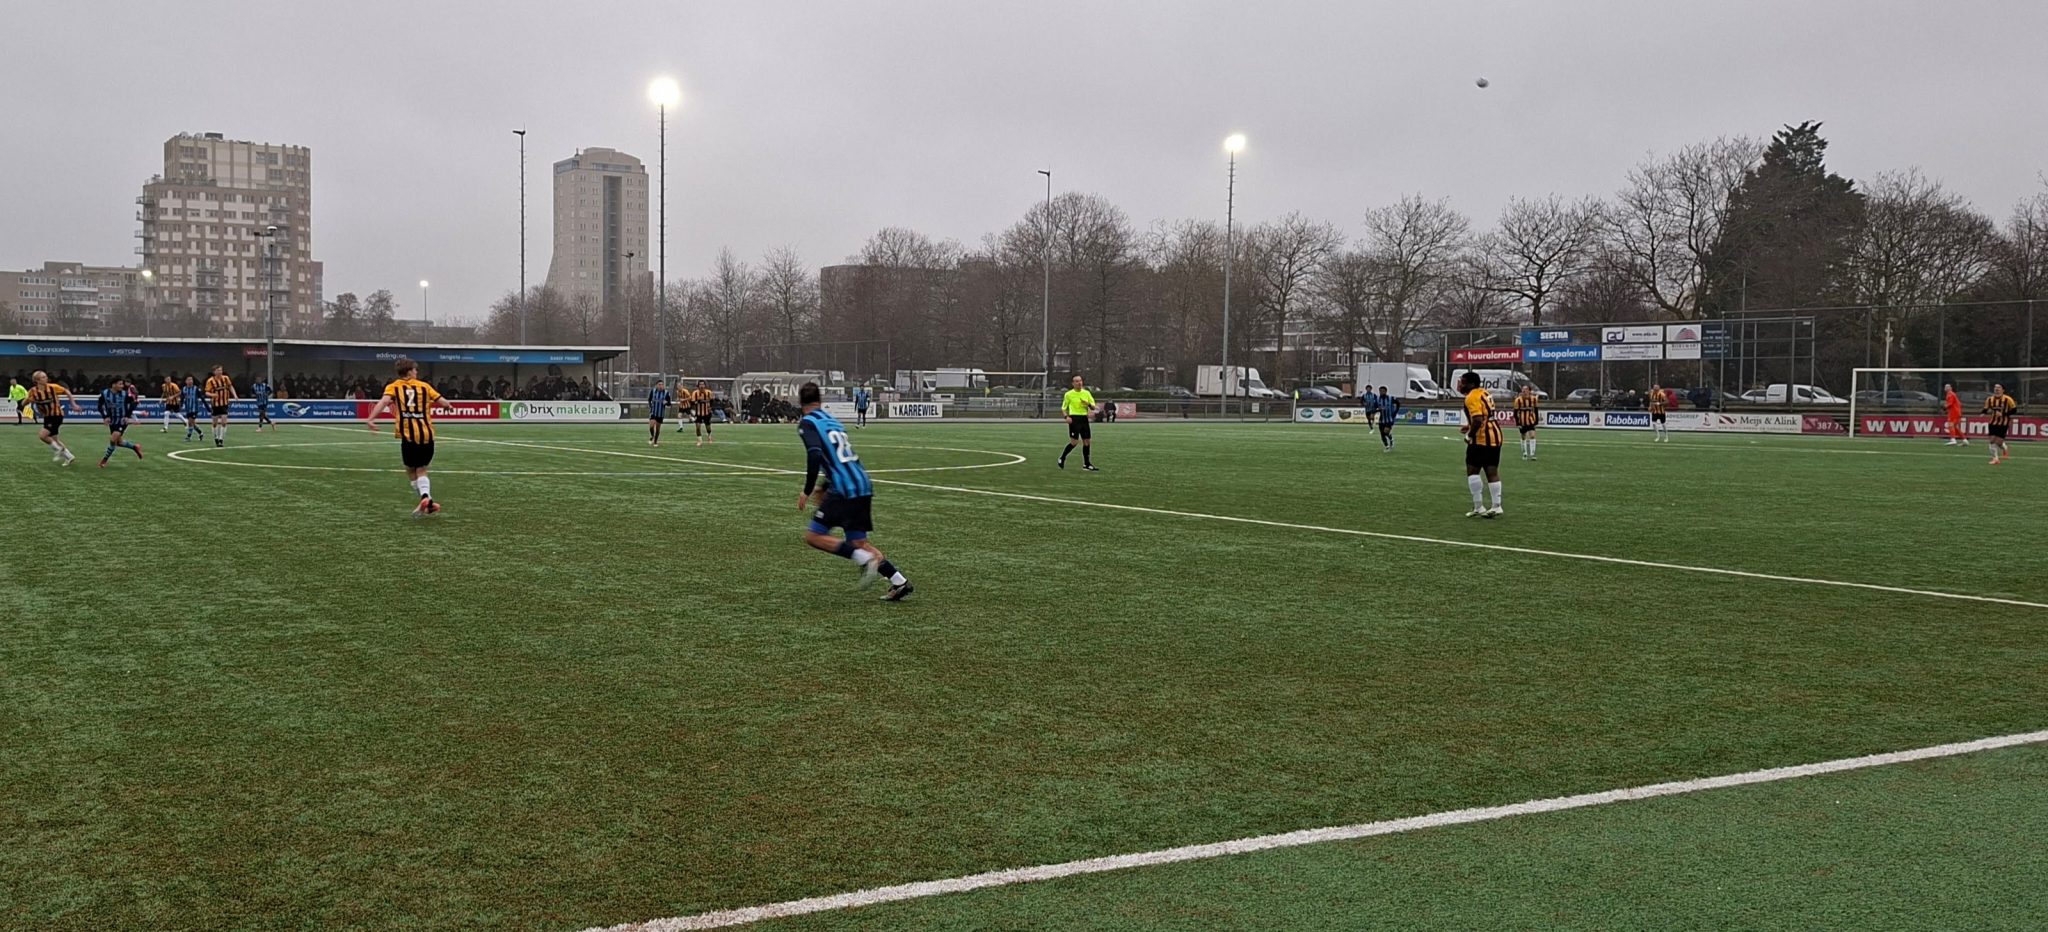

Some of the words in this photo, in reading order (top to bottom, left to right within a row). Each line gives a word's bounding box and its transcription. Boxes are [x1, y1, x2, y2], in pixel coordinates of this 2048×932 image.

[1468, 350, 1519, 360] huuralarm.nl
[1541, 347, 1597, 360] koopalarm.nl
[405, 389, 416, 407] 2
[530, 403, 554, 417] brix
[556, 405, 615, 415] makelaars
[899, 404, 939, 417] KARREWIEL
[1547, 414, 1589, 425] Rabobank
[1606, 415, 1649, 426] Rabobank
[1774, 416, 1798, 426] Alink
[1816, 422, 1832, 431] 387
